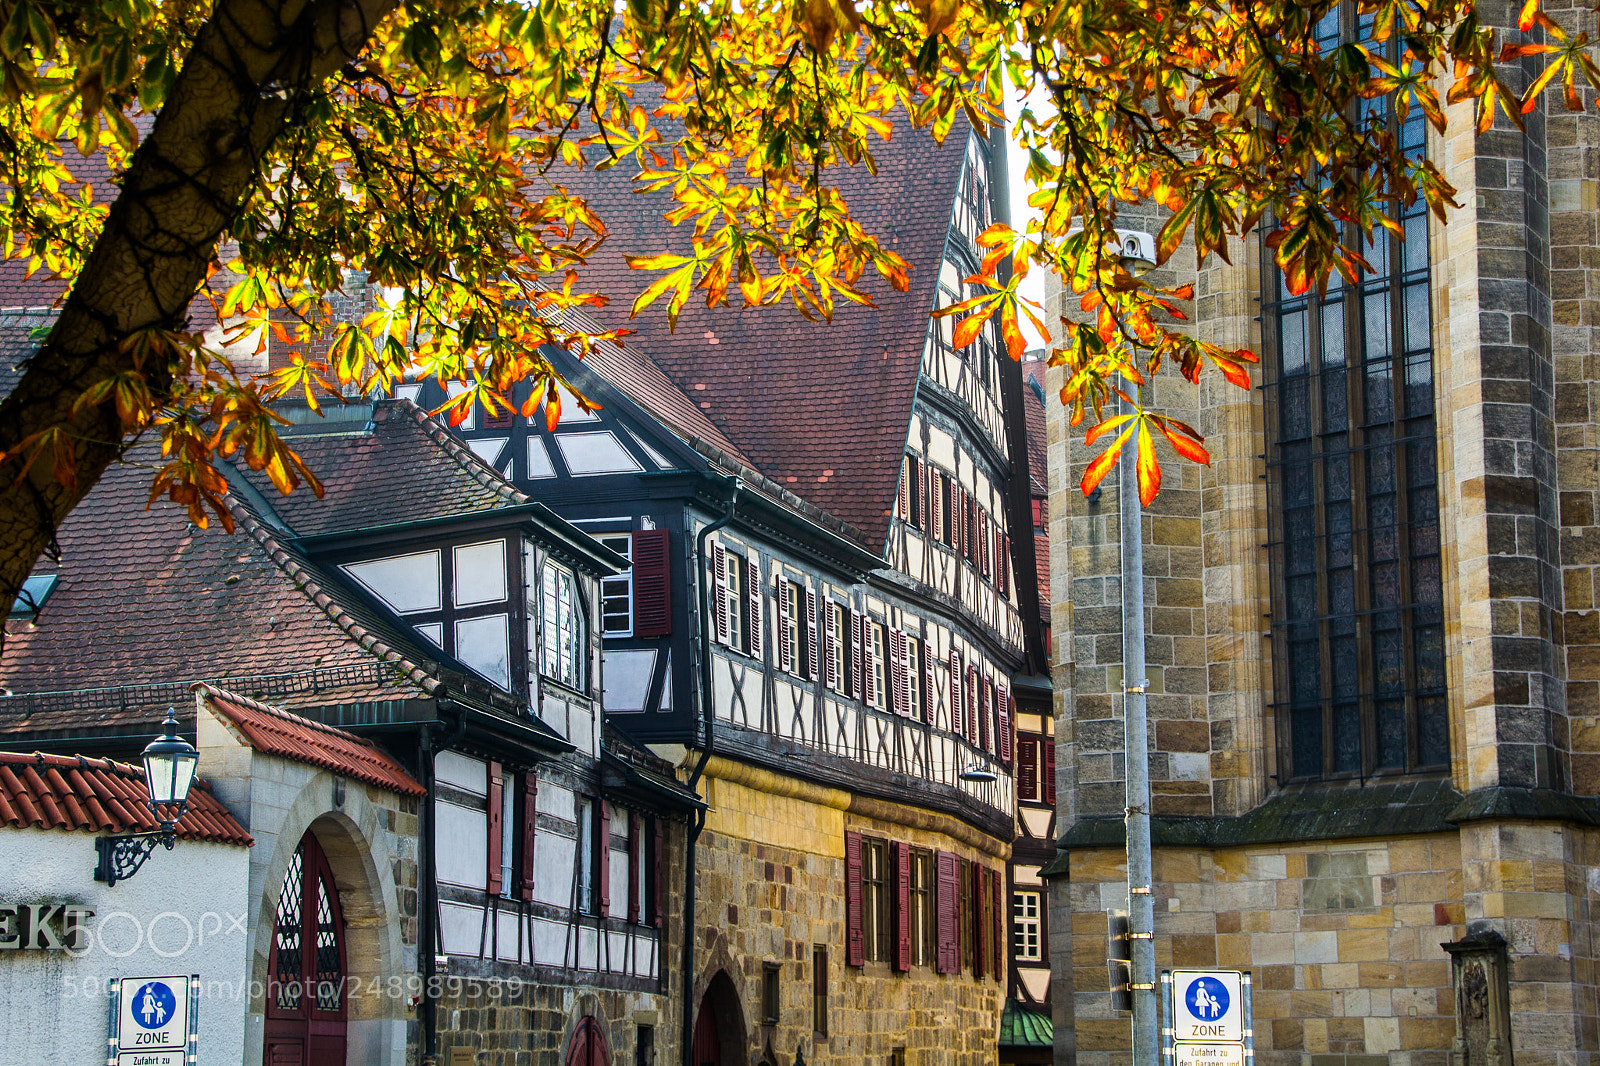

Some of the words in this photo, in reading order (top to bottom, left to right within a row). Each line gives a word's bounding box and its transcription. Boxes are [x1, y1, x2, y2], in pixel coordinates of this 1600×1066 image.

[1192, 1025, 1226, 1036] ZONE
[135, 1032, 170, 1045] ZONE
[1191, 1048, 1217, 1057] Zufahrt
[133, 1056, 159, 1066] Zufahrt
[162, 1057, 171, 1065] zu
